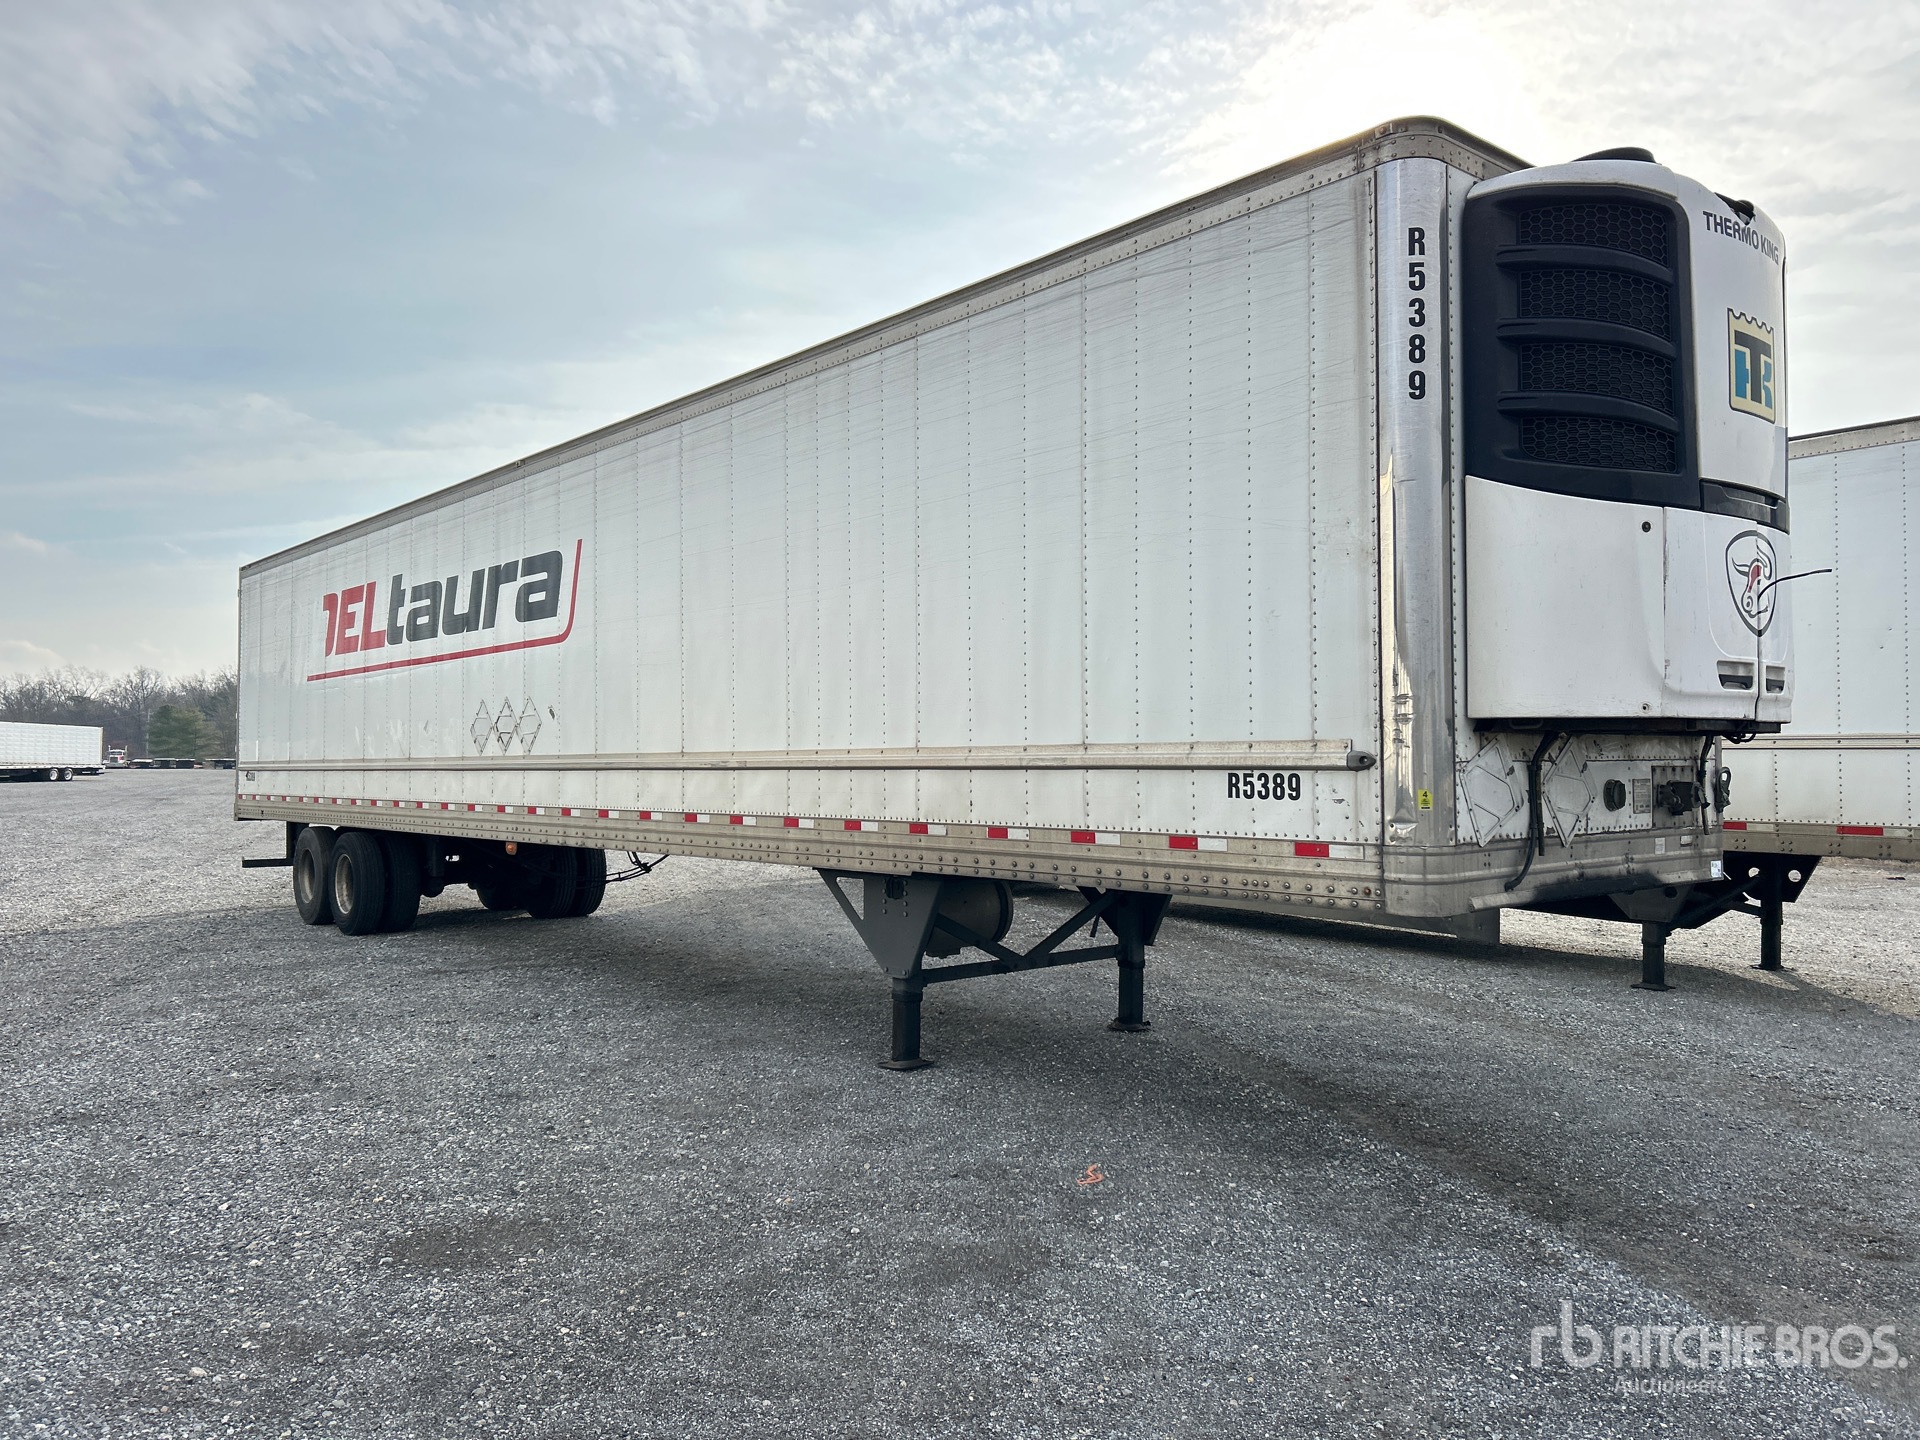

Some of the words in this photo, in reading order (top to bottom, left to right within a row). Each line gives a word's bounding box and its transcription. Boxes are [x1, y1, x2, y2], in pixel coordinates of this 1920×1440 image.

[1702, 210, 1759, 250] THERMO
[1760, 234, 1779, 265] KING
[1408, 226, 1426, 400] R5389
[1227, 772, 1301, 800] R5389
